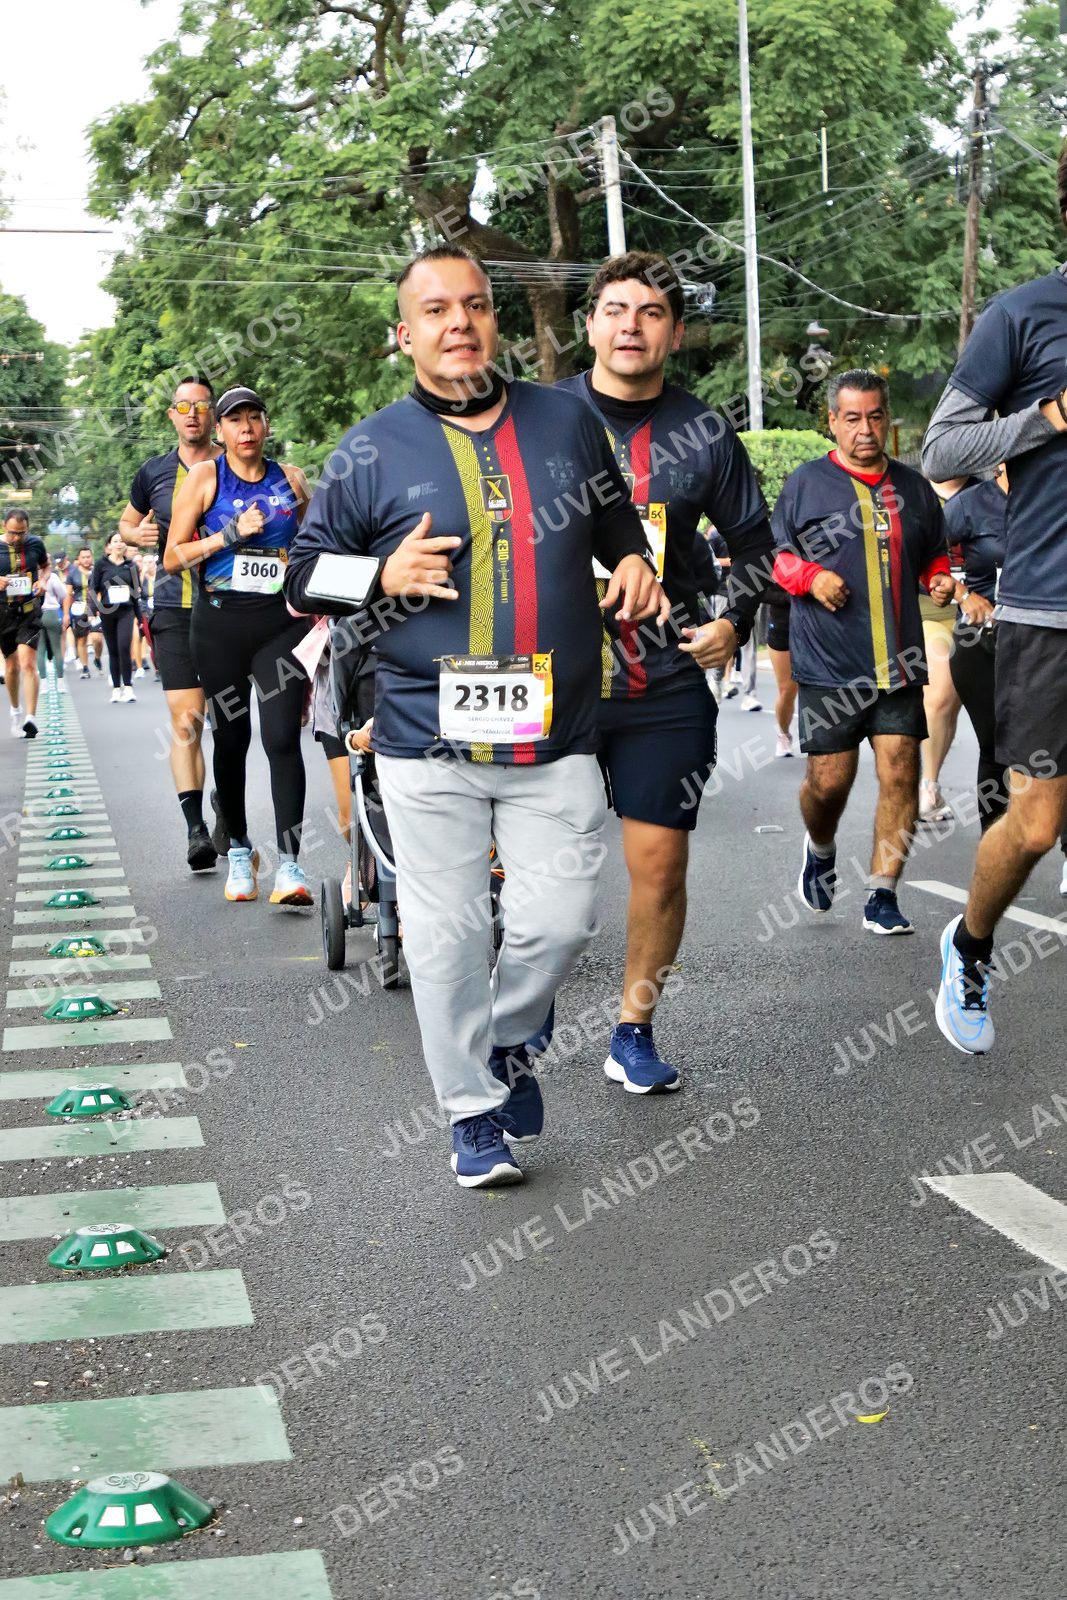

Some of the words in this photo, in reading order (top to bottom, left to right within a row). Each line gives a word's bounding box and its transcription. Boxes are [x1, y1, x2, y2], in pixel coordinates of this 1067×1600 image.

[651, 510, 662, 519] 5K
[240, 562, 278, 578] 3060
[534, 662, 548, 671] 5K
[454, 684, 529, 712] 2318
